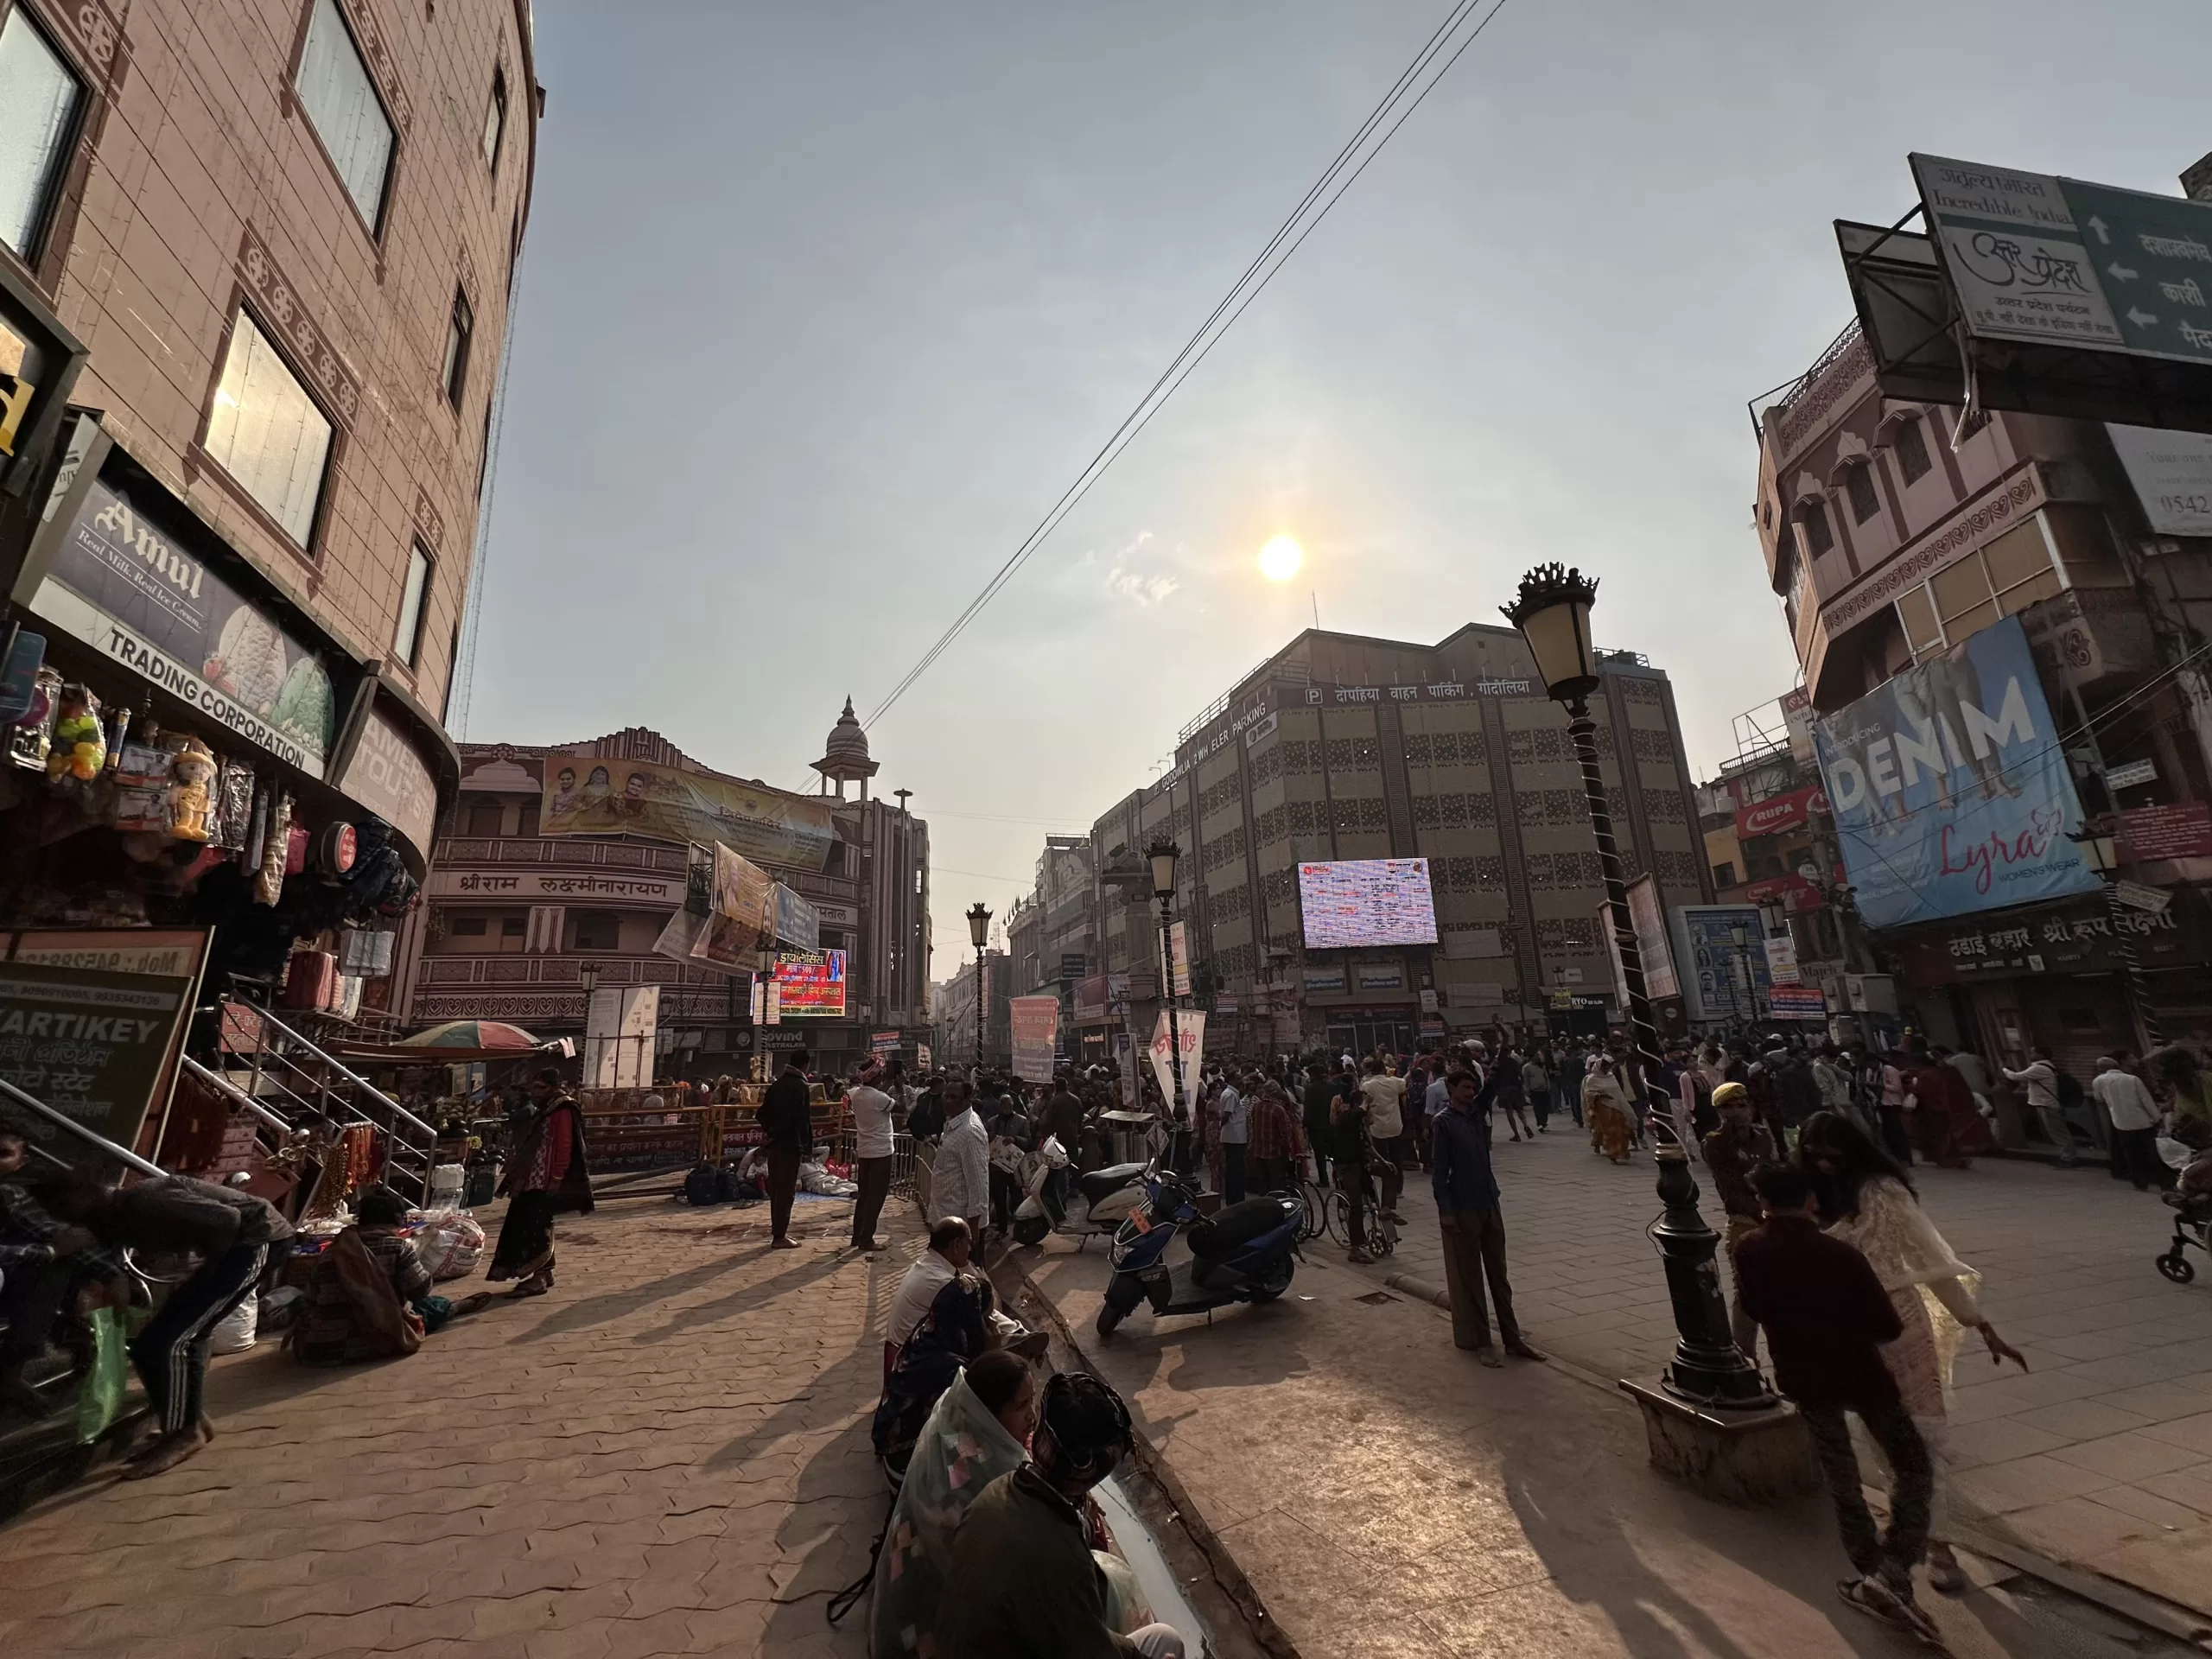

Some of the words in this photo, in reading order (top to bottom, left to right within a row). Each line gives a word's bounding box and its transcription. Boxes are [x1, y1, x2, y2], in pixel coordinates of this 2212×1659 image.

[1931, 189, 2024, 218] Incredible
[2159, 278, 2206, 308] काशी
[78, 530, 106, 556] Real
[134, 572, 156, 594] Real
[156, 588, 171, 606] Ice
[95, 500, 204, 600] Amul
[111, 628, 199, 701] TRADING
[200, 690, 306, 769] CORPORATION
[1335, 685, 1380, 704] दोपहिया
[1389, 686, 1419, 702] वाहन
[1161, 759, 1191, 788] GODOWLIA
[1232, 702, 1266, 736] PARKING
[1824, 722, 1881, 756] INTRODUCING
[1828, 676, 2036, 813] DENIM
[1756, 804, 1794, 822] RUPA
[1941, 823, 2047, 895] Lyra
[1998, 867, 2044, 883] WOMEN'S
[2045, 858, 2080, 874] WEAR
[539, 875, 667, 898] लक्ष्मीनारायण
[817, 906, 847, 921] पताल
[767, 1030, 803, 1042] ovind
